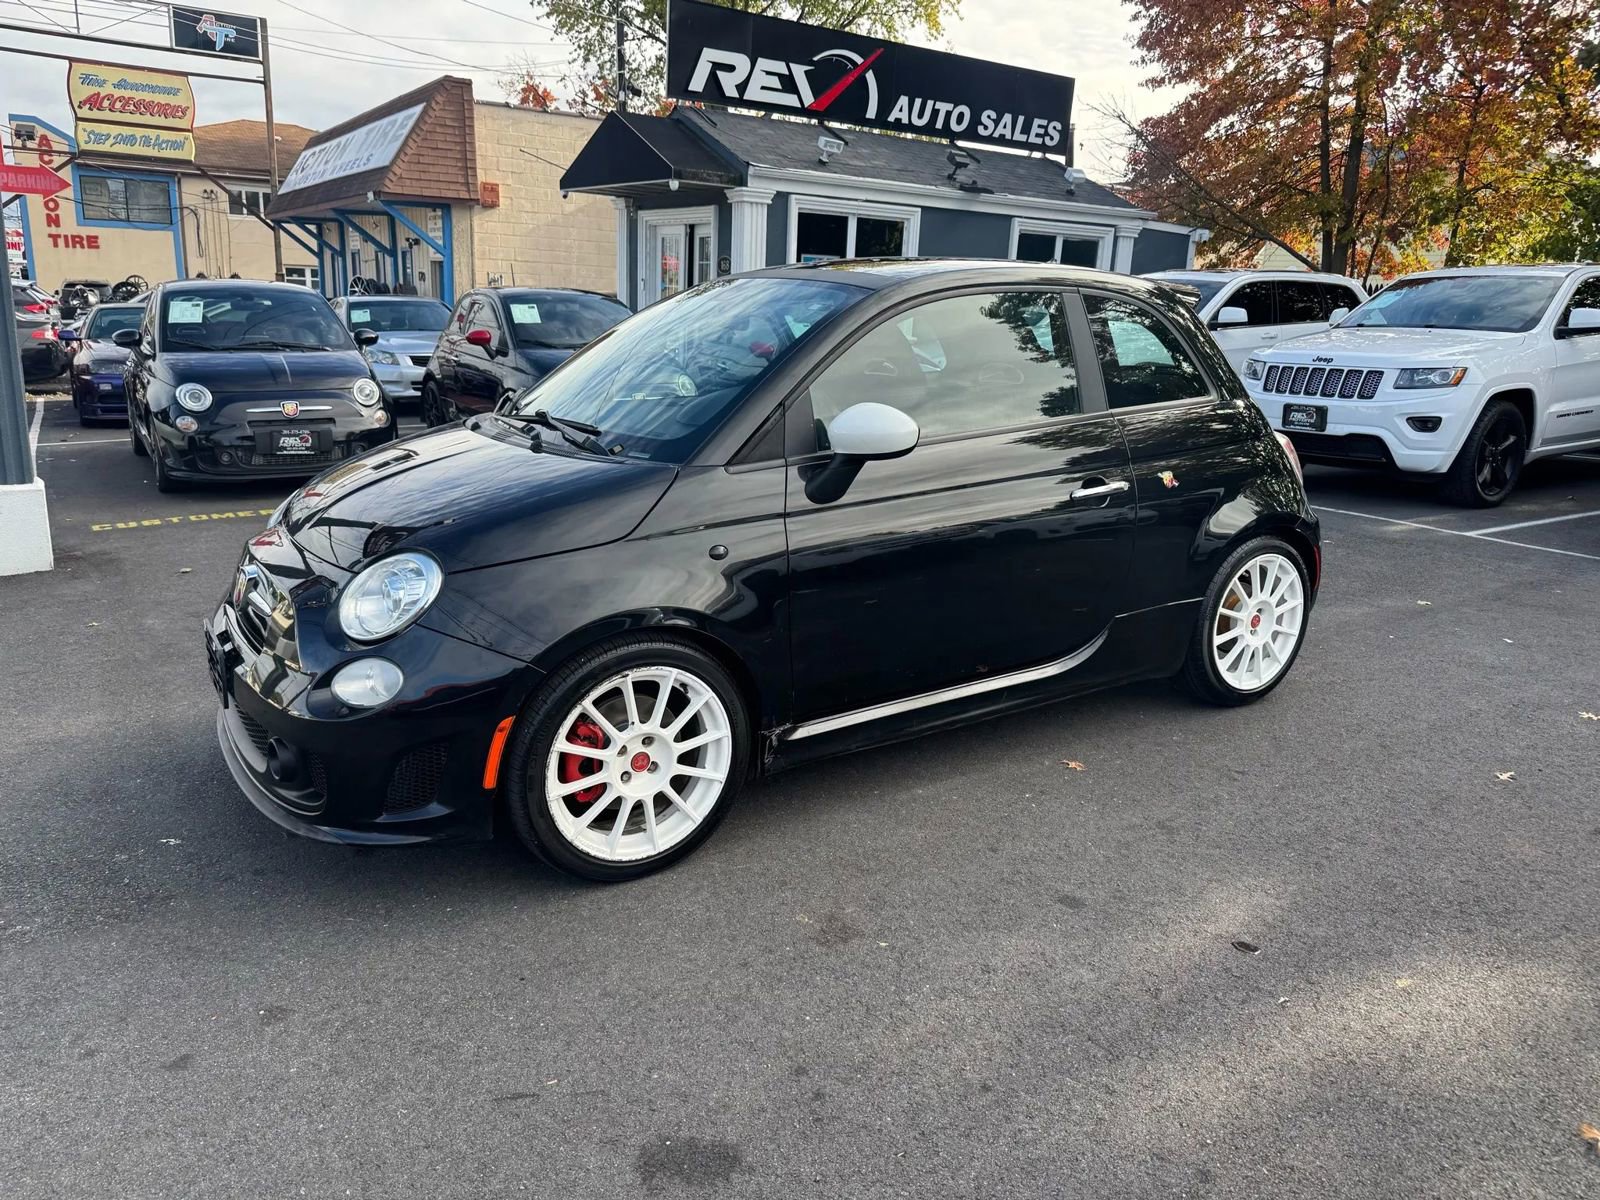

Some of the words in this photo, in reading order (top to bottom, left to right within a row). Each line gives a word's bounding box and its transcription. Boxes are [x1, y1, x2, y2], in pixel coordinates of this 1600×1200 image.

[77, 91, 190, 119] ACCESSORIES
[888, 95, 971, 133] AUTO
[977, 113, 1063, 147] SALES
[289, 135, 356, 177] ACTION
[0, 171, 61, 191] PARKING
[38, 134, 61, 228] ACON
[47, 233, 100, 249] TIRE
[1312, 355, 1334, 364] Jeep
[91, 508, 275, 531] CUSTOMER
